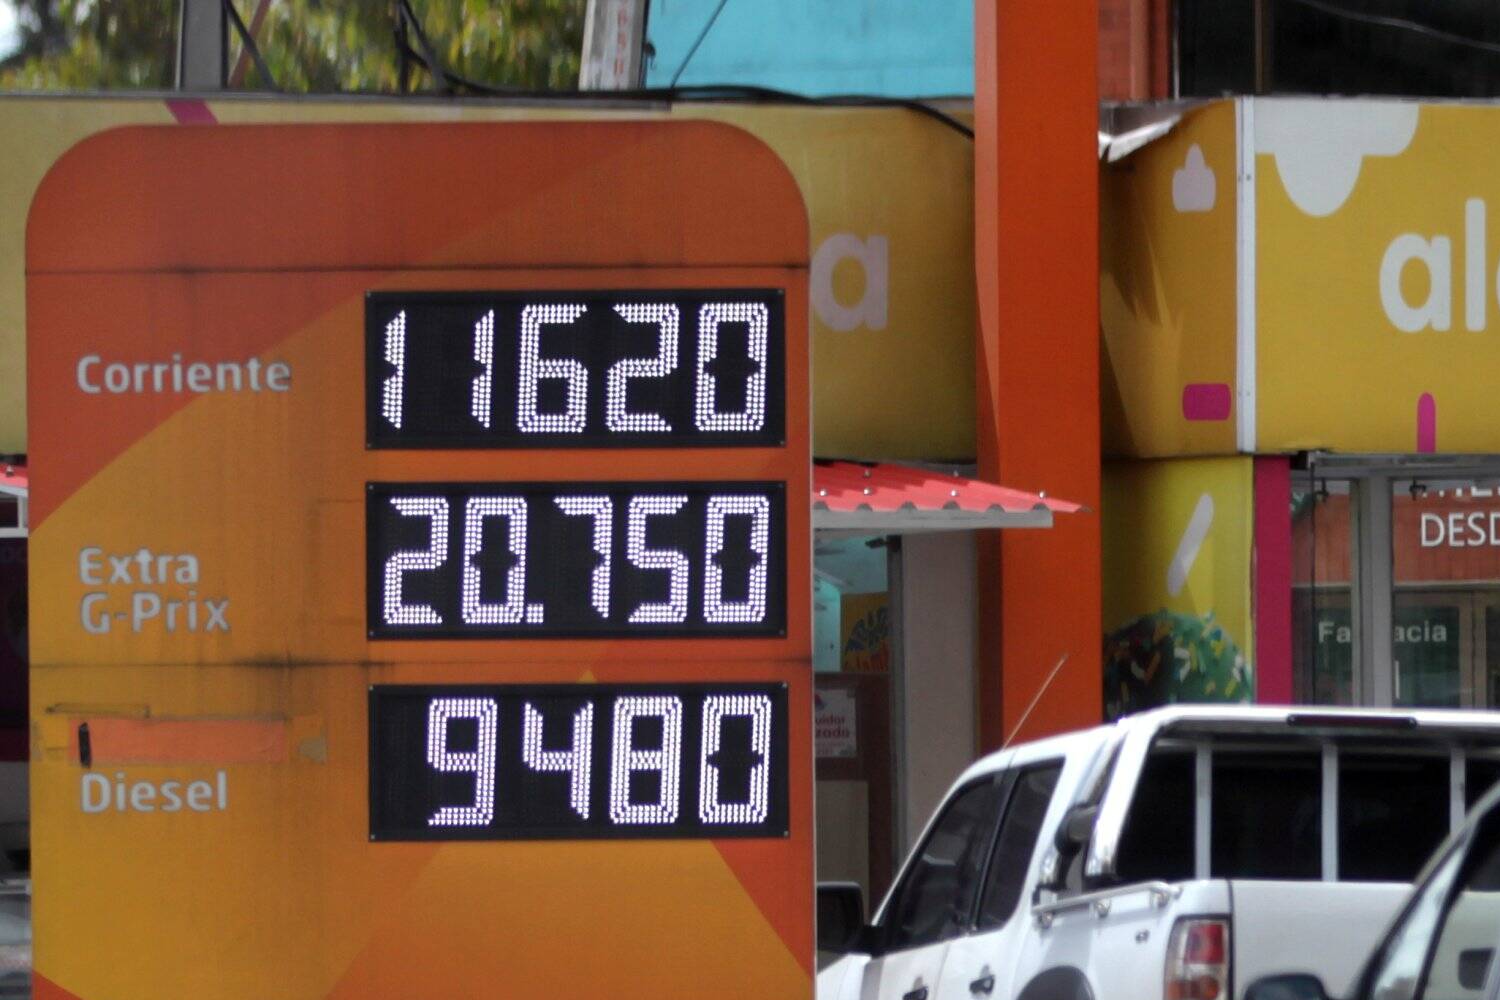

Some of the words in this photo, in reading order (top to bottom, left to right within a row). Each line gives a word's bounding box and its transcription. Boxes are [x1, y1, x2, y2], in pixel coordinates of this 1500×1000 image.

[76, 354, 291, 394] Corriente
[382, 302, 769, 433] 11620
[79, 546, 199, 586] Extra
[383, 495, 770, 626] 20.750
[81, 591, 231, 634] G-Prix
[426, 695, 772, 826] 9480
[81, 771, 228, 813] Diesel
